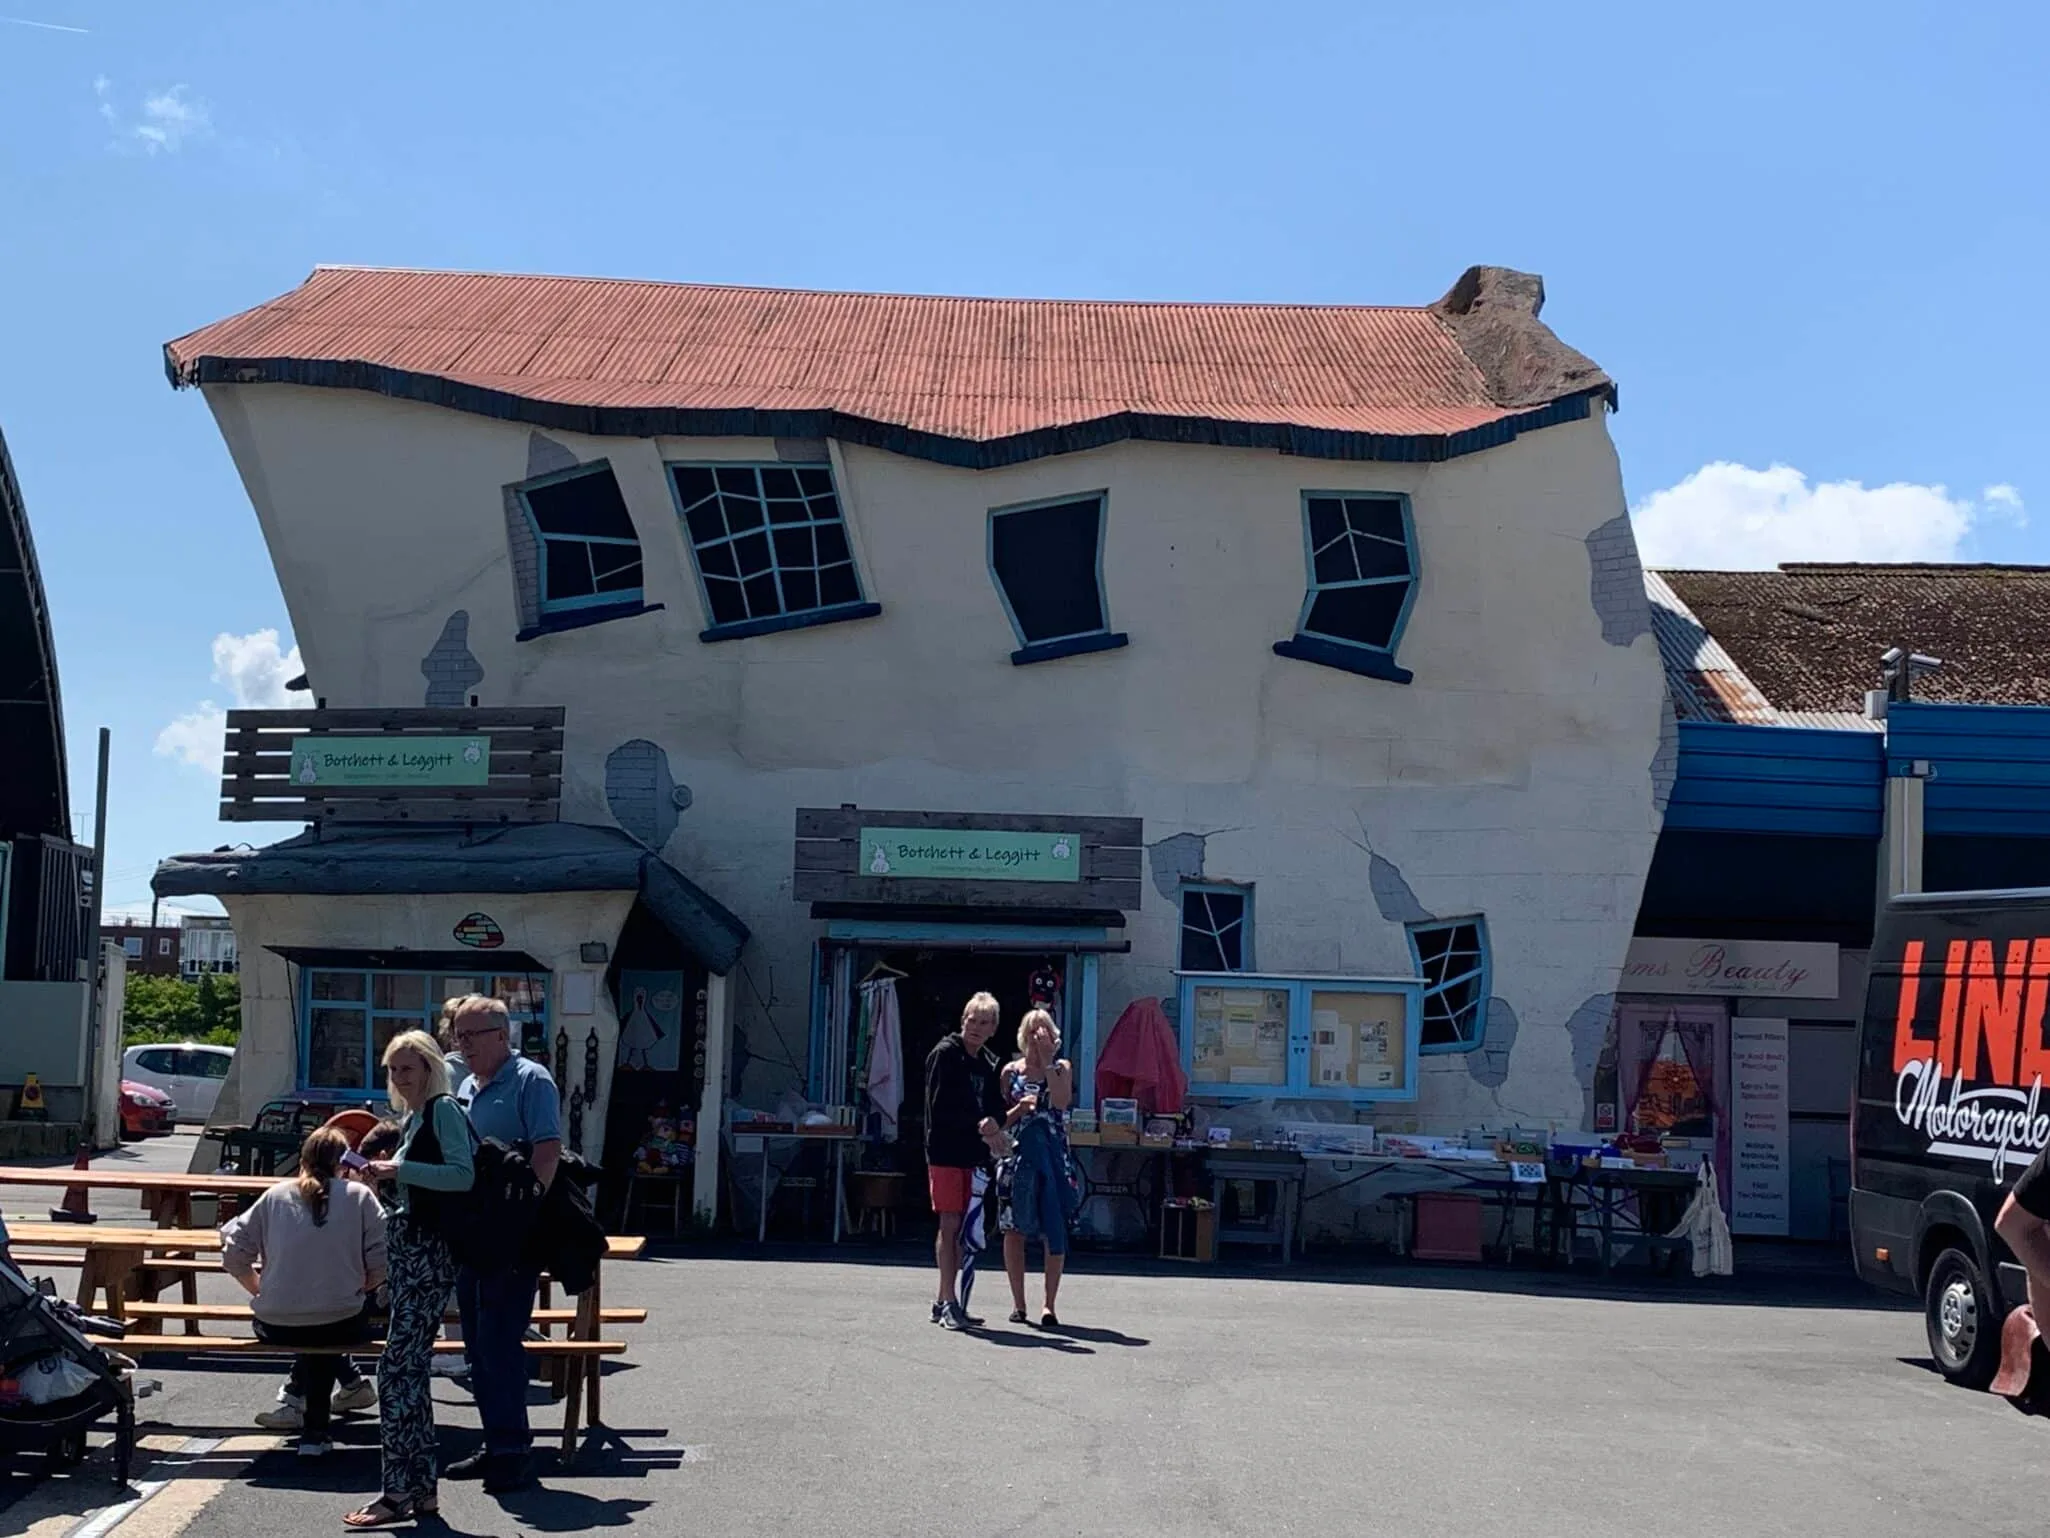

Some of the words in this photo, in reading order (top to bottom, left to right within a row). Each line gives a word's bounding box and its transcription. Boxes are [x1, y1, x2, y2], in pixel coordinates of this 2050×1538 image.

[324, 753, 384, 767] Botchett
[388, 757, 400, 767] &
[403, 754, 454, 771] Leggitt
[897, 844, 964, 860] Botchett
[969, 850, 981, 860] &
[986, 848, 1041, 865] Leggitt
[1685, 944, 1809, 992] Beauty
